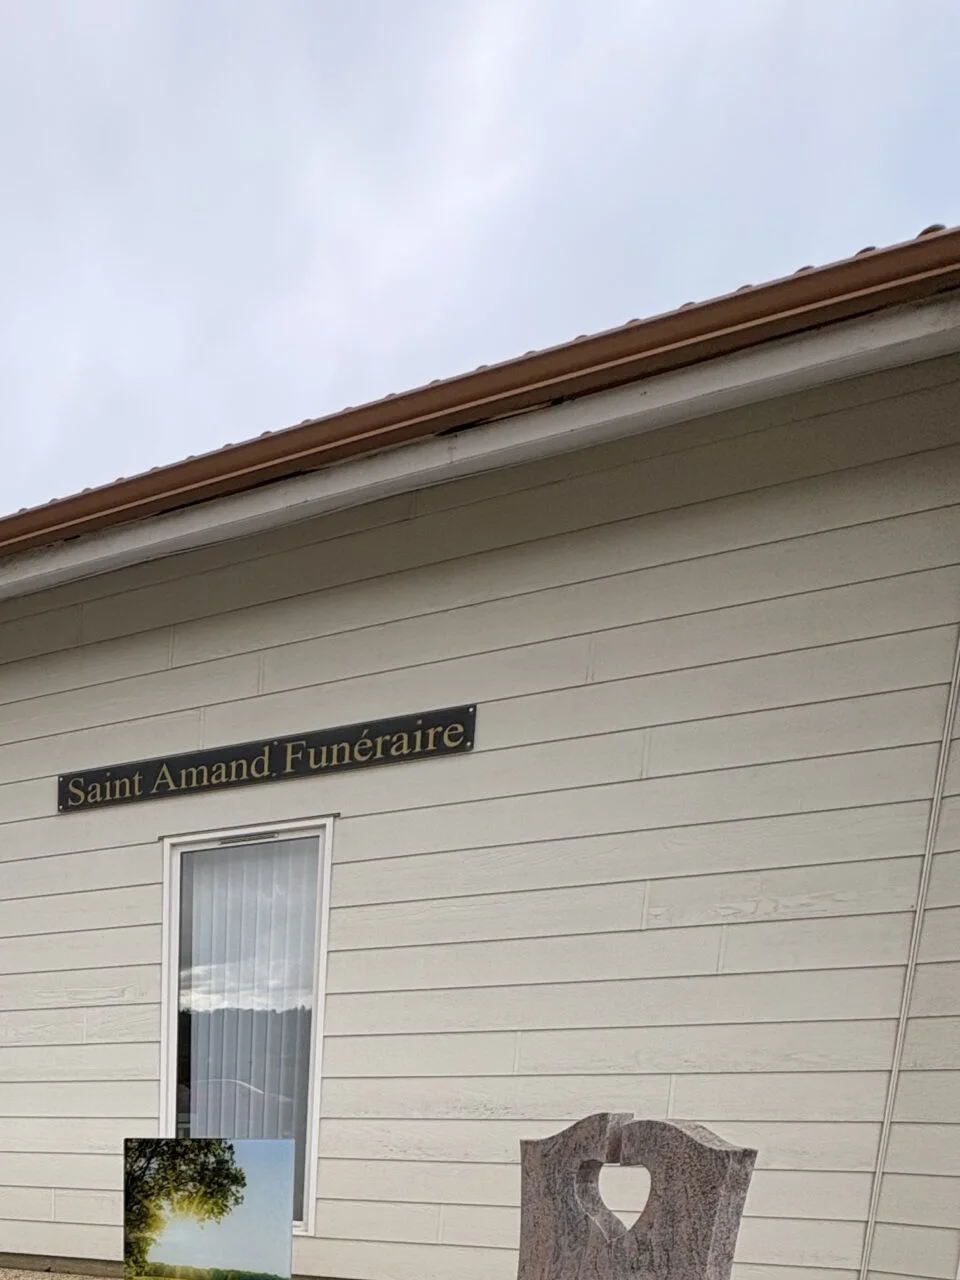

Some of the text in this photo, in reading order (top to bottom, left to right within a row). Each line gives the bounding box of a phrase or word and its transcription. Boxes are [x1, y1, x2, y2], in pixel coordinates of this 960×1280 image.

[67, 719, 466, 806] Saint Amand Funéraire
